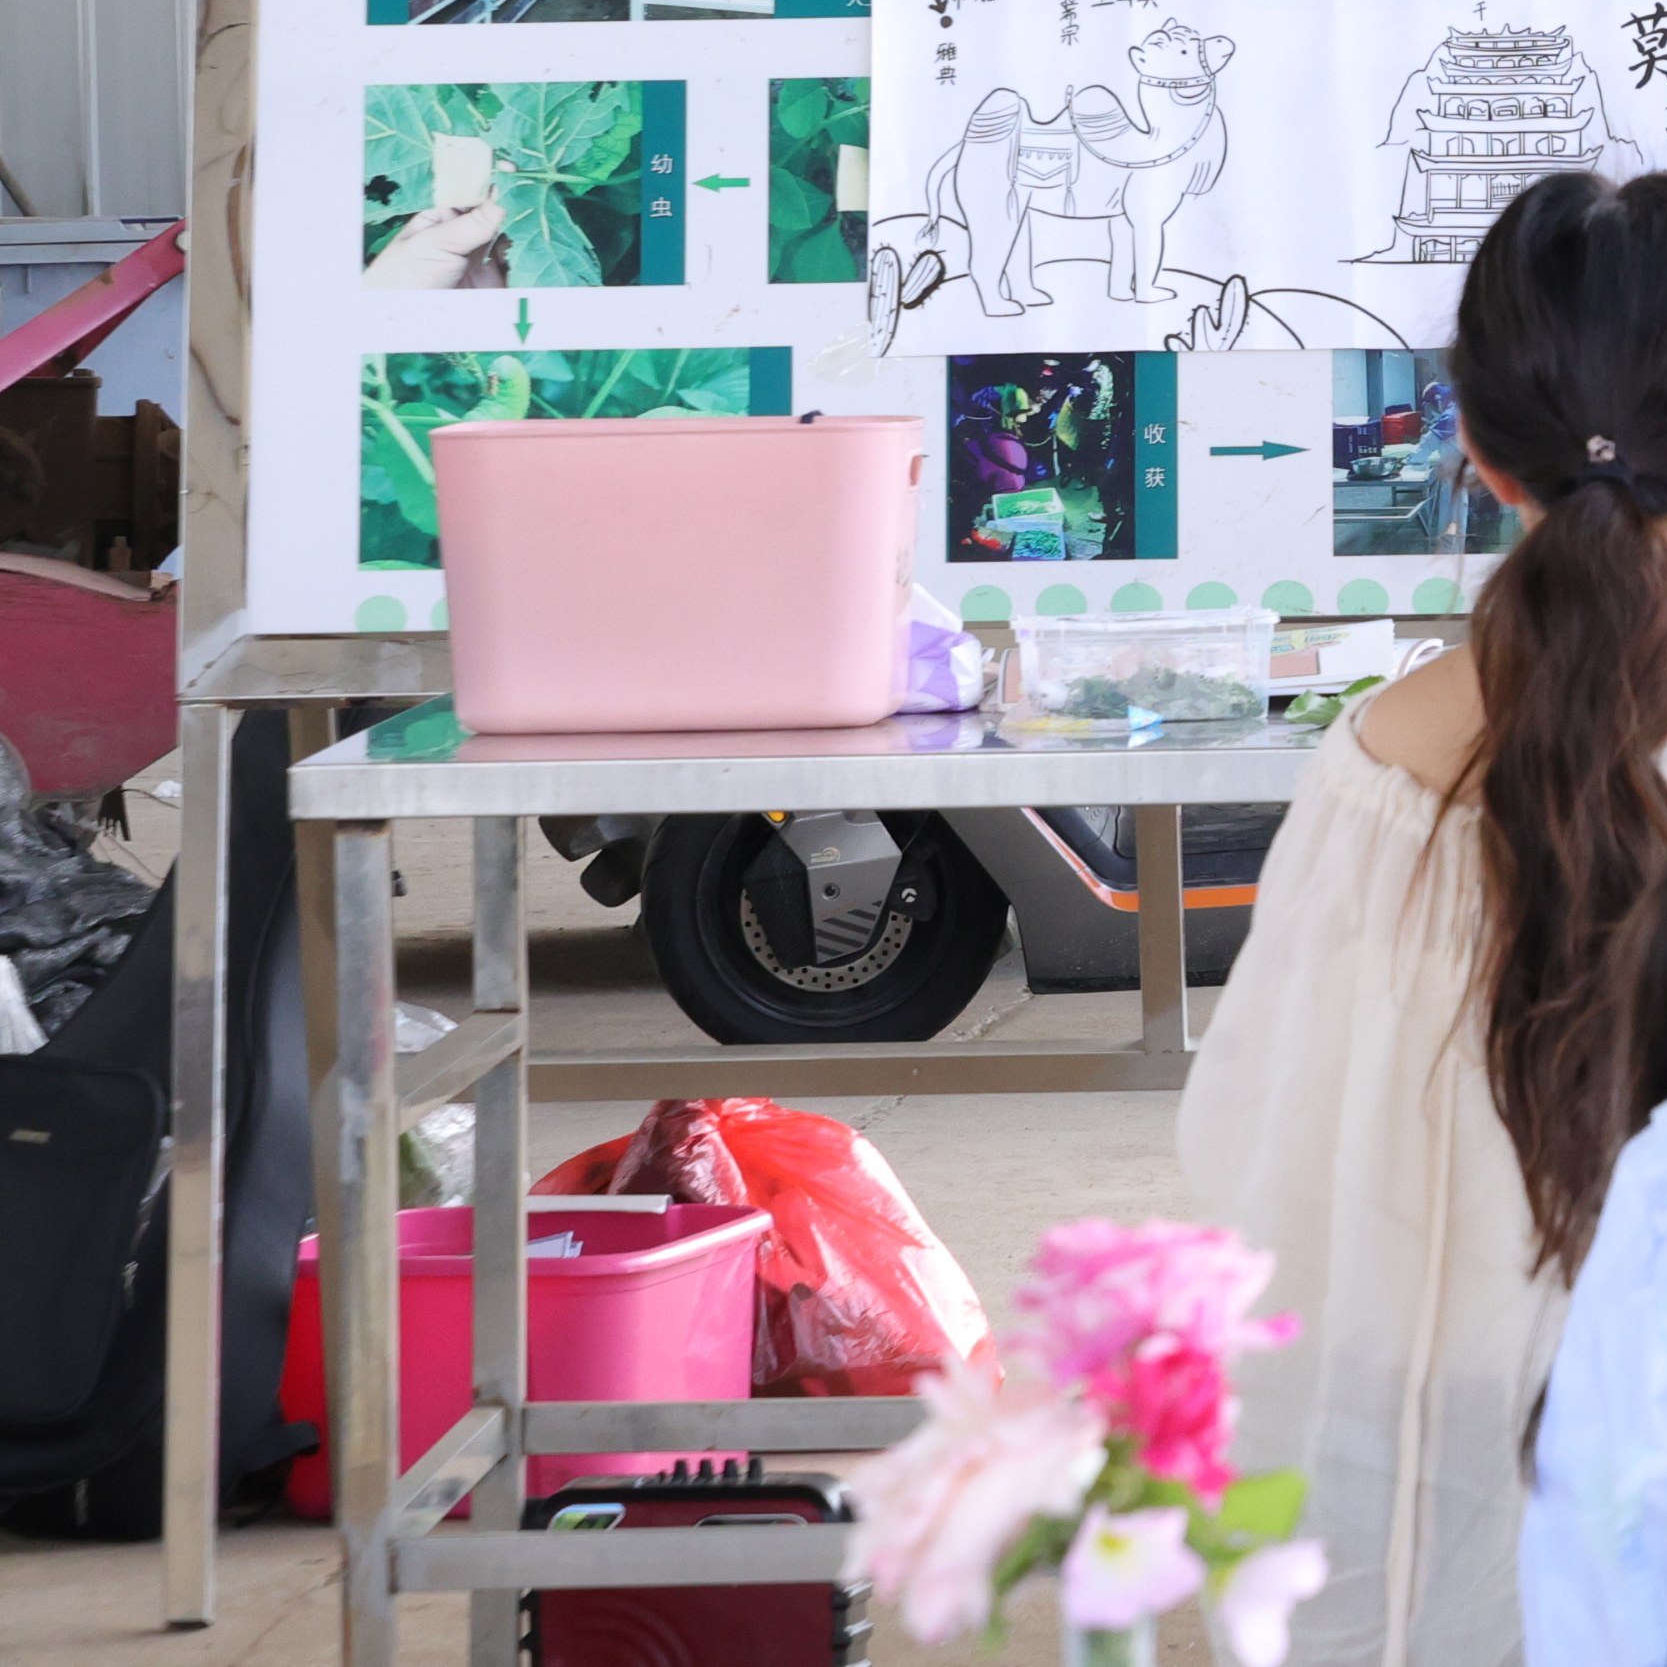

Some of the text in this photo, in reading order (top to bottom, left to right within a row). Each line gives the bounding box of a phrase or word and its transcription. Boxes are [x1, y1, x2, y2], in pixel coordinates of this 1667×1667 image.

[935, 42, 957, 86] 雅典
[649, 153, 673, 218] 幼虫
[1143, 423, 1167, 488] 收获
